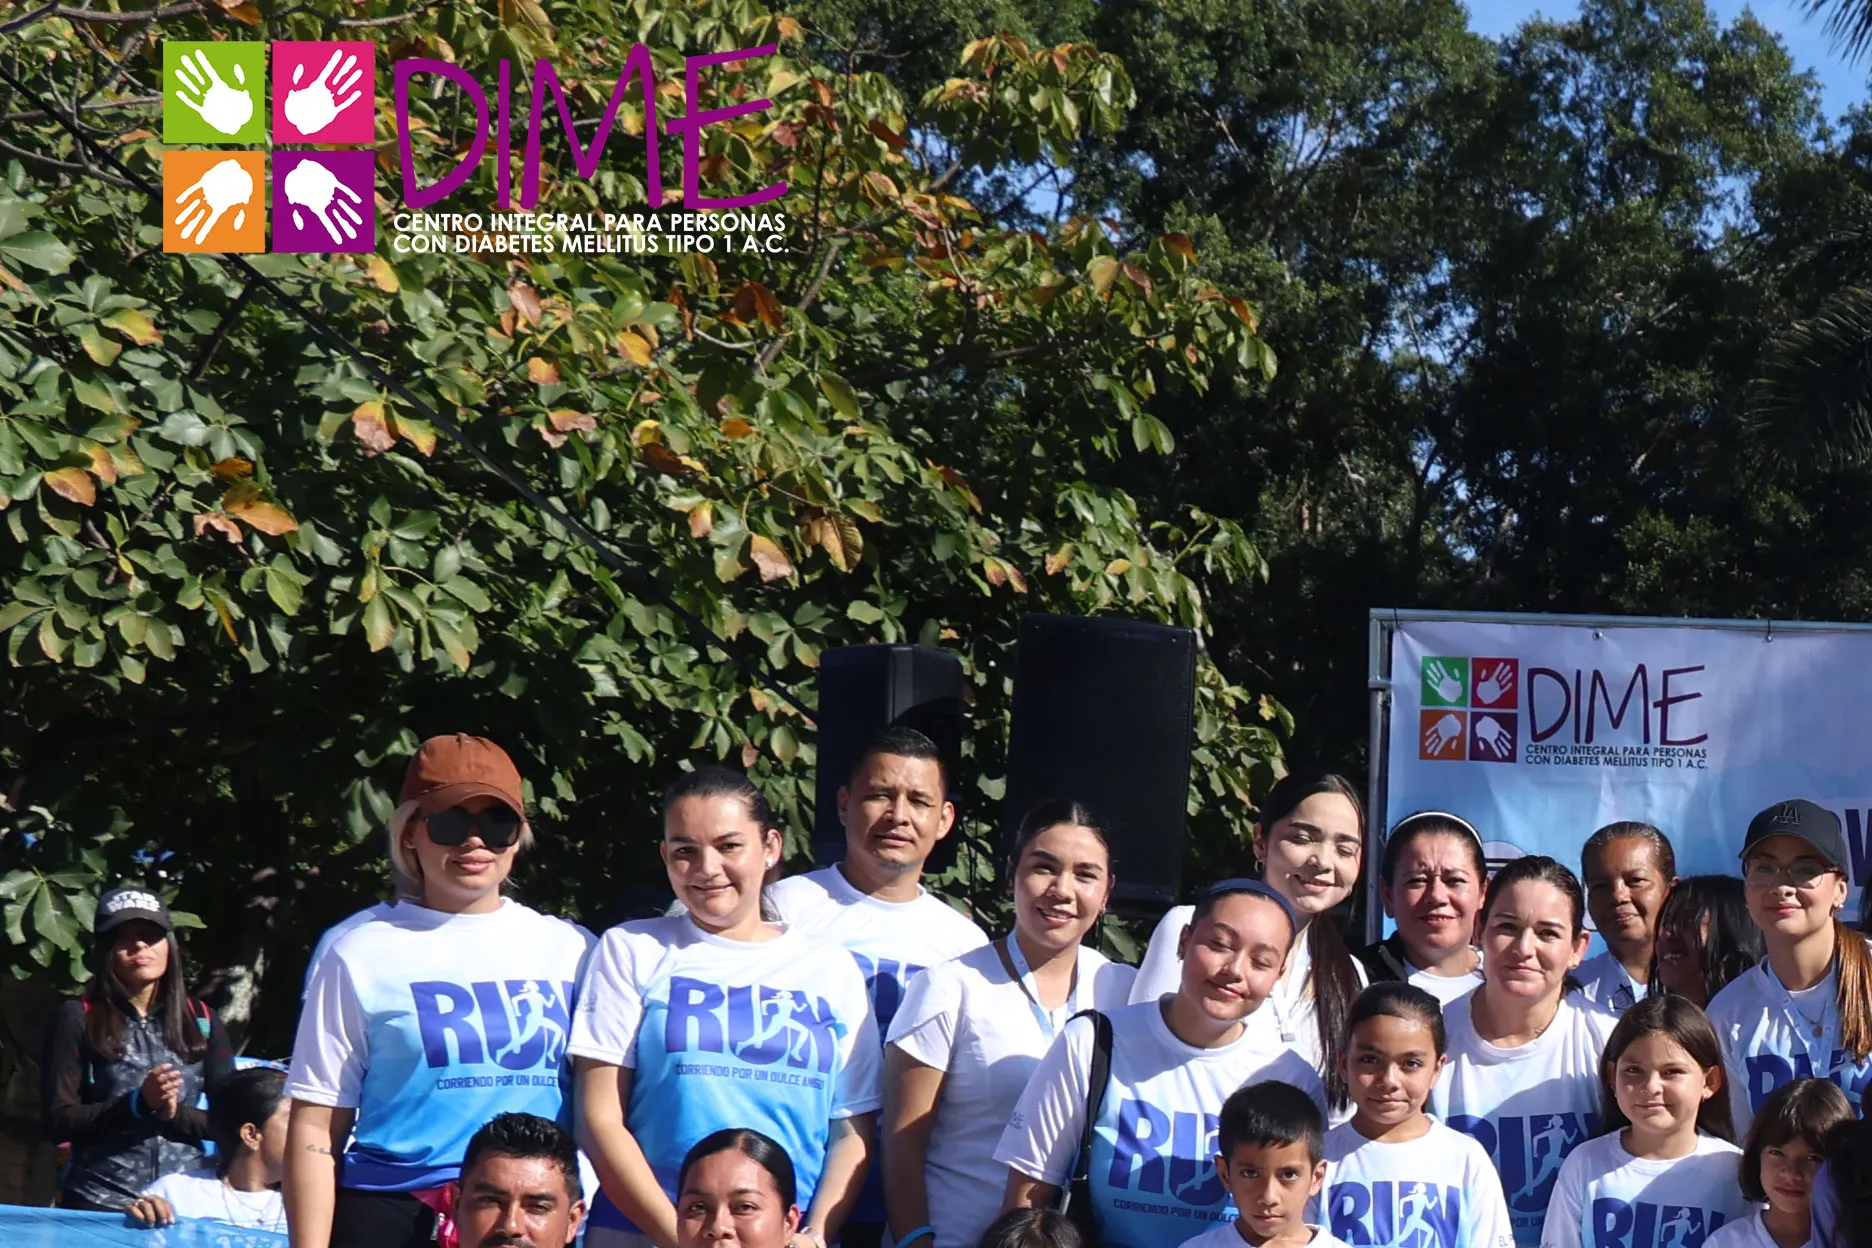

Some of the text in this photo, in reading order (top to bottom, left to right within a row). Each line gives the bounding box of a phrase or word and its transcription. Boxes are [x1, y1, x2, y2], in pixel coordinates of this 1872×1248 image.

[1527, 663, 1708, 746] DIME
[1525, 744, 1707, 759] CENTRO INTEGRAL PARA PERSONAS
[1525, 755, 1551, 765] CON
[1554, 755, 1600, 766] DIABETES
[1603, 756, 1648, 767] MELLITUS
[1651, 757, 1674, 768] TIPO
[1686, 760, 1709, 770] A.C.
[409, 979, 574, 1071] RUN
[665, 975, 836, 1074] RUN
[437, 1075, 493, 1091] CORRIENDO
[495, 1075, 514, 1088] POR
[516, 1075, 530, 1087] UN
[675, 1063, 730, 1078] CORRIENDO
[732, 1066, 753, 1080] POR
[754, 1069, 768, 1081] UN
[770, 1071, 800, 1086] DULCE
[1108, 1097, 1229, 1207] RU
[1113, 1198, 1169, 1216] CORRIENDO
[1171, 1206, 1192, 1219] POR
